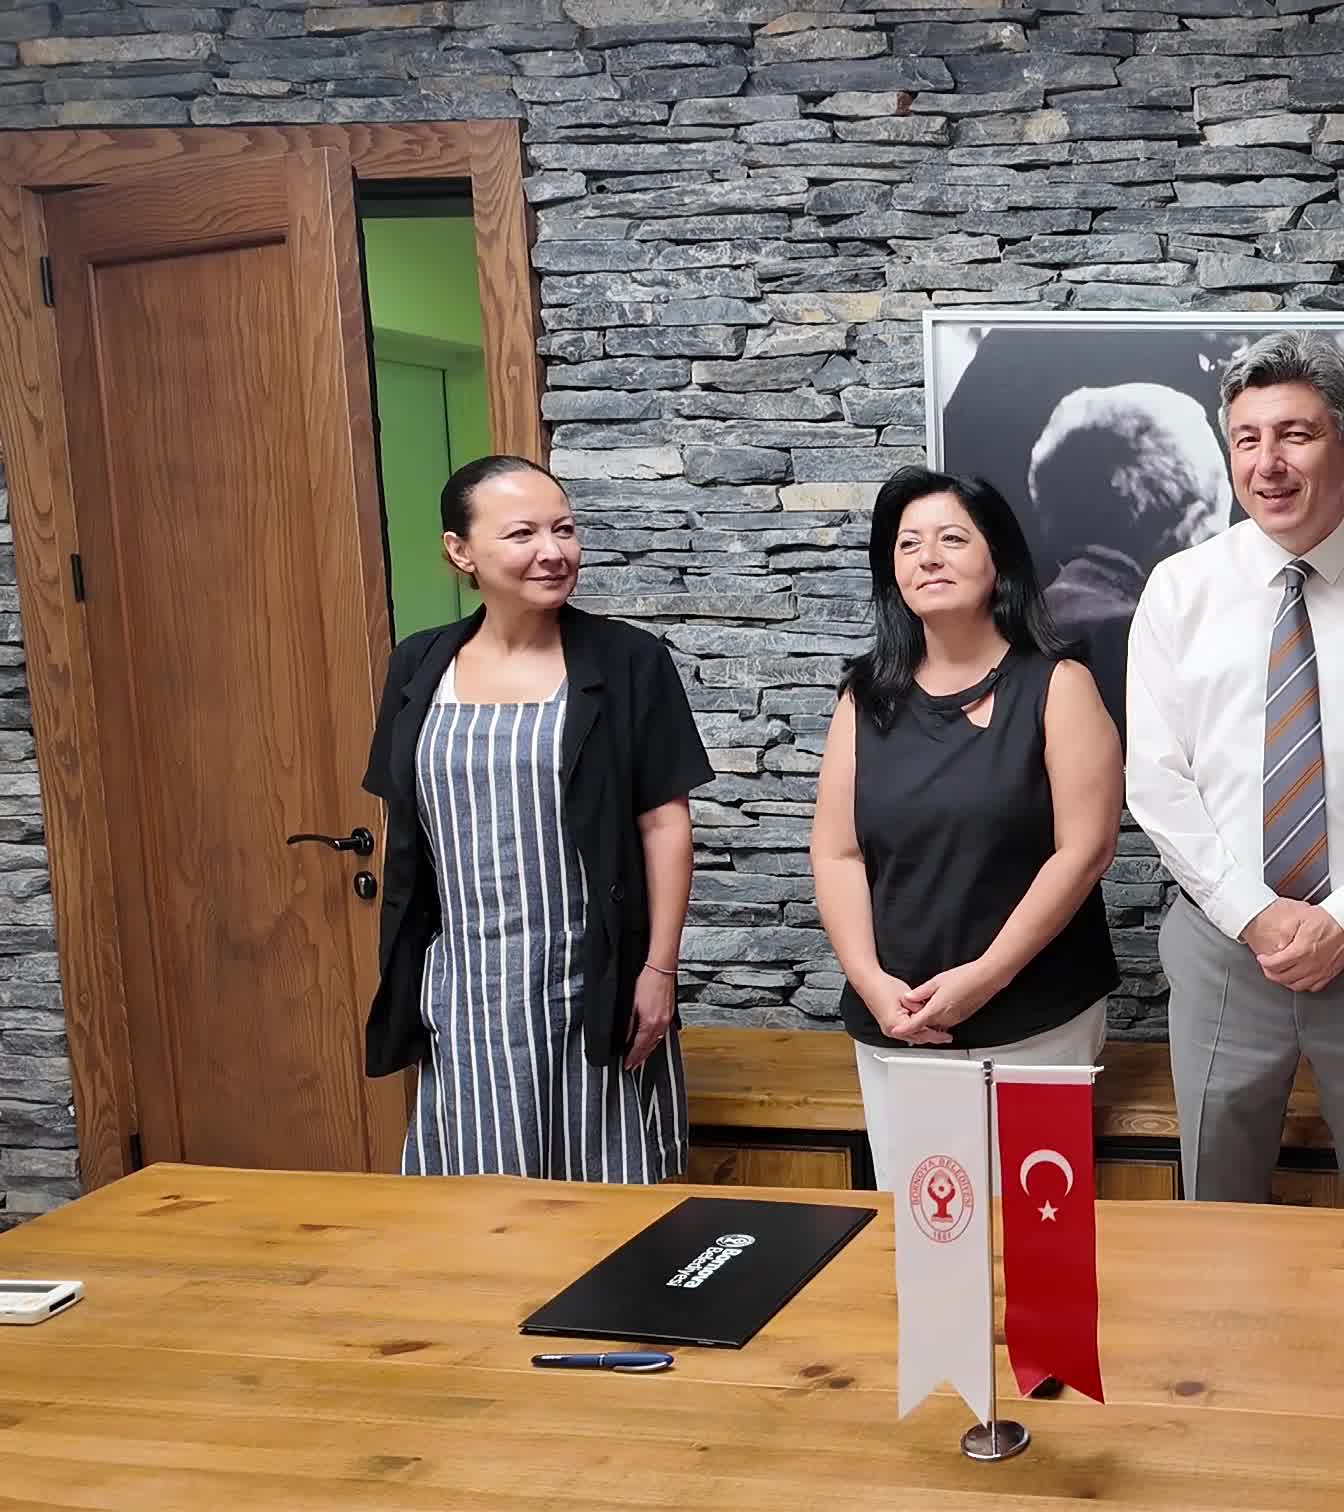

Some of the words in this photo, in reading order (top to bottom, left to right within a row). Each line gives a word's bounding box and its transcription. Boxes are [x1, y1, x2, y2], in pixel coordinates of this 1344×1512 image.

[911, 1159, 936, 1206] BORNOVA
[666, 1246, 724, 1287] Belediyesi
[683, 1248, 743, 1288] Bornova
